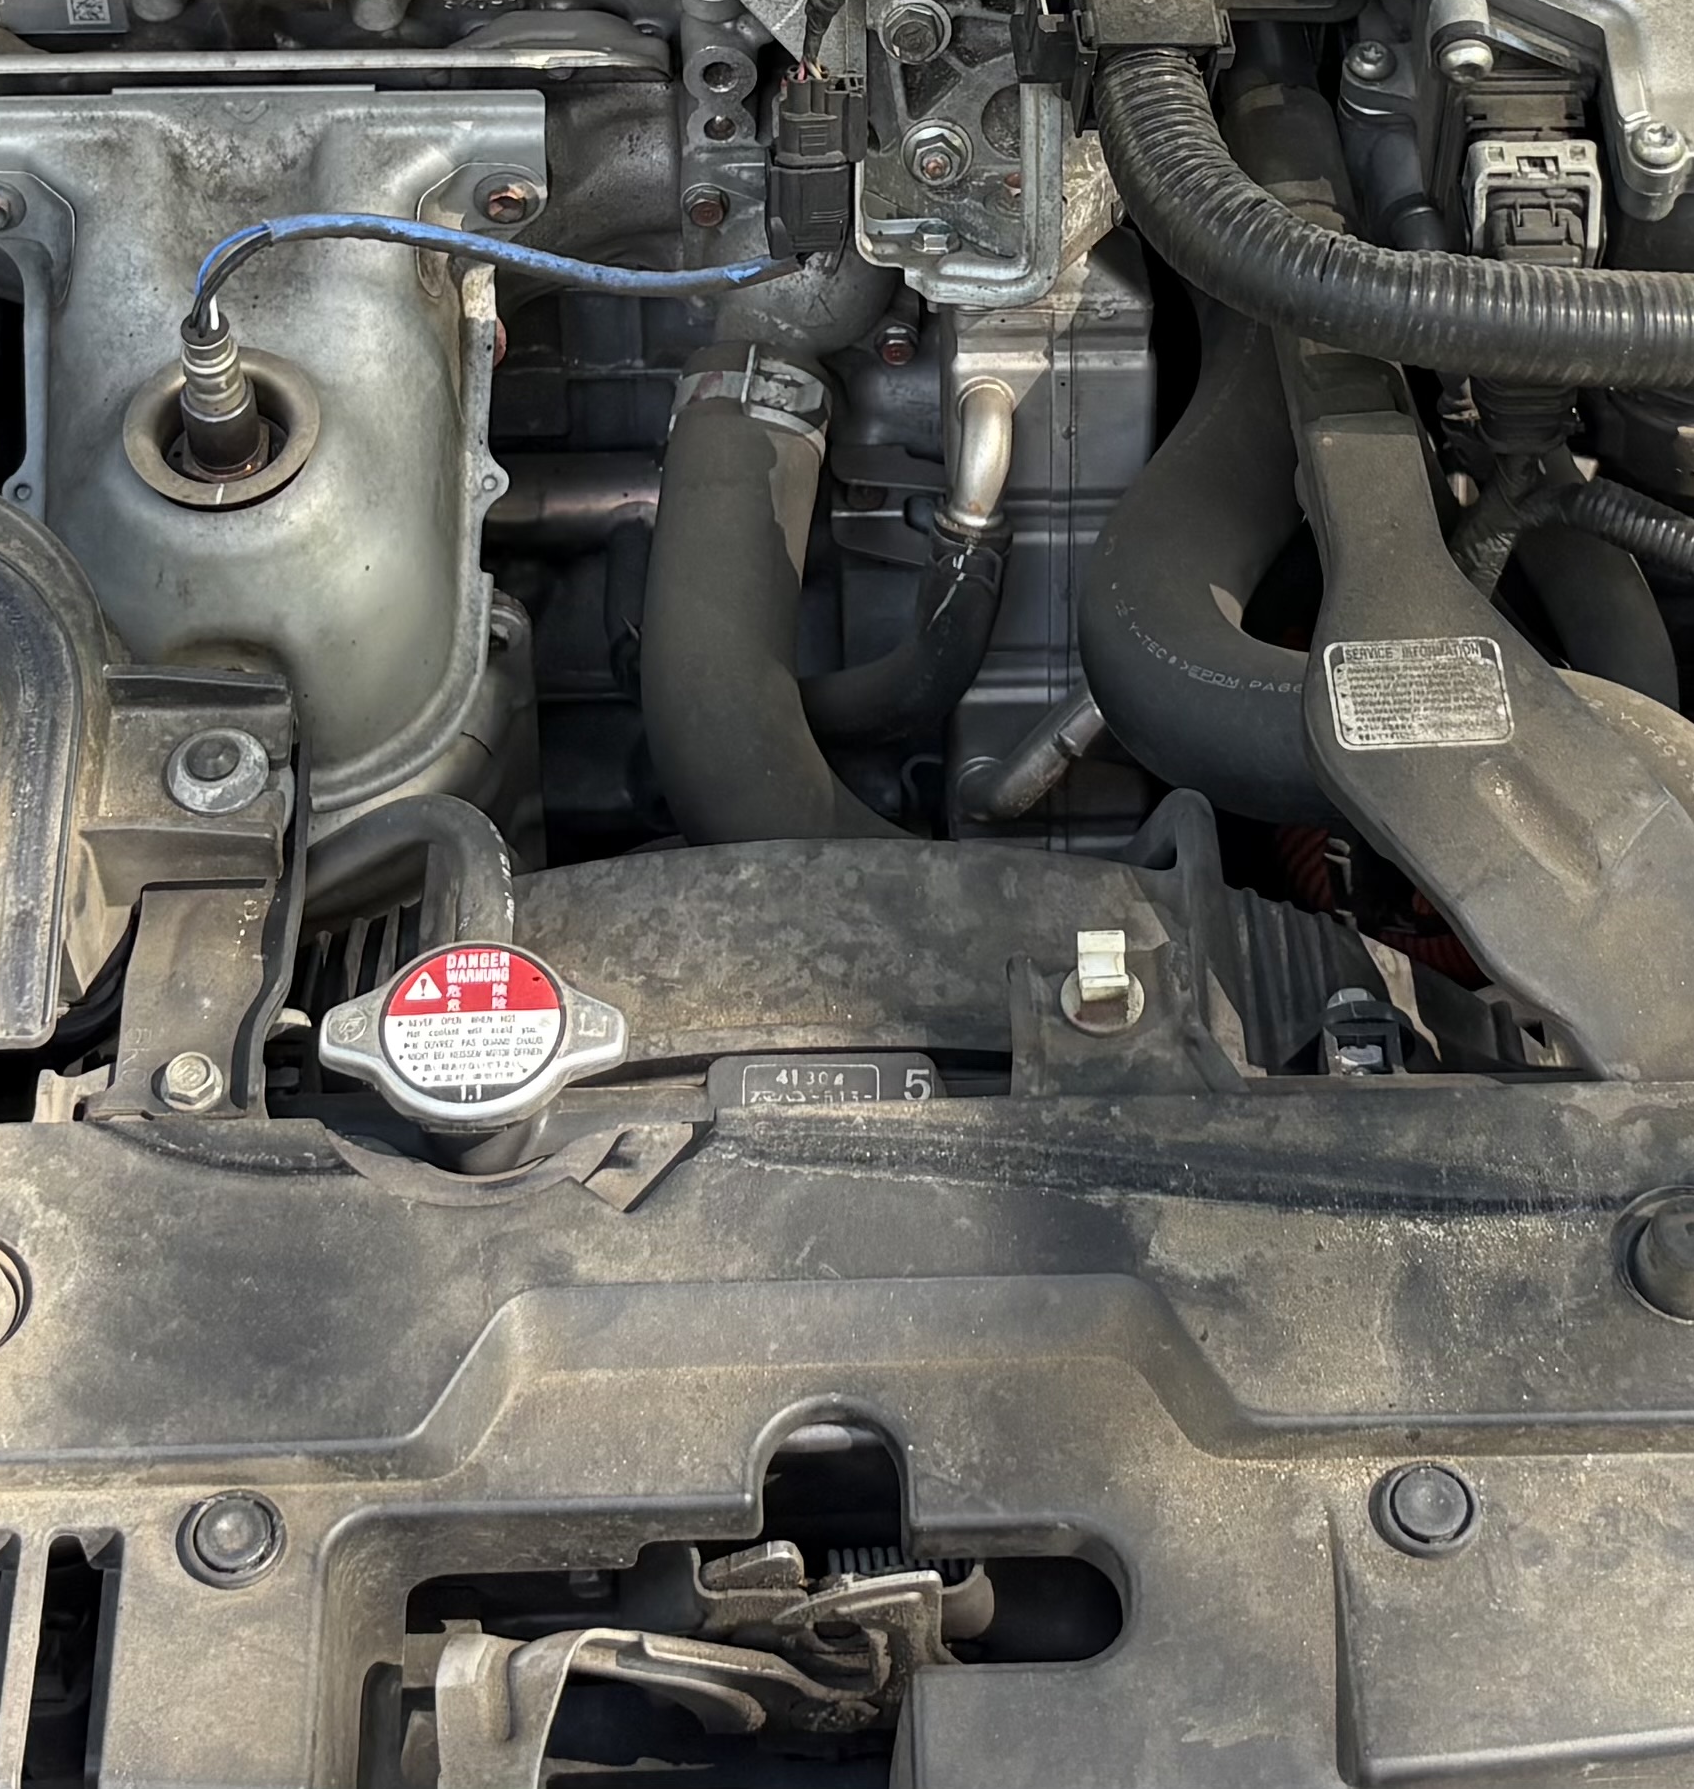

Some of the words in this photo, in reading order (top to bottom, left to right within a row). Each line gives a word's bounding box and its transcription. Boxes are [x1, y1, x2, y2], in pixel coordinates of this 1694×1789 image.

[1128, 621, 1168, 660] Y-TEC
[1345, 645, 1394, 660] SERVICE
[1402, 642, 1479, 659] INFORMATION
[446, 951, 510, 969] DANGER
[446, 968, 509, 984] WARNUNG
[460, 1084, 482, 1101] 1.1
[903, 1068, 932, 1101] 5
